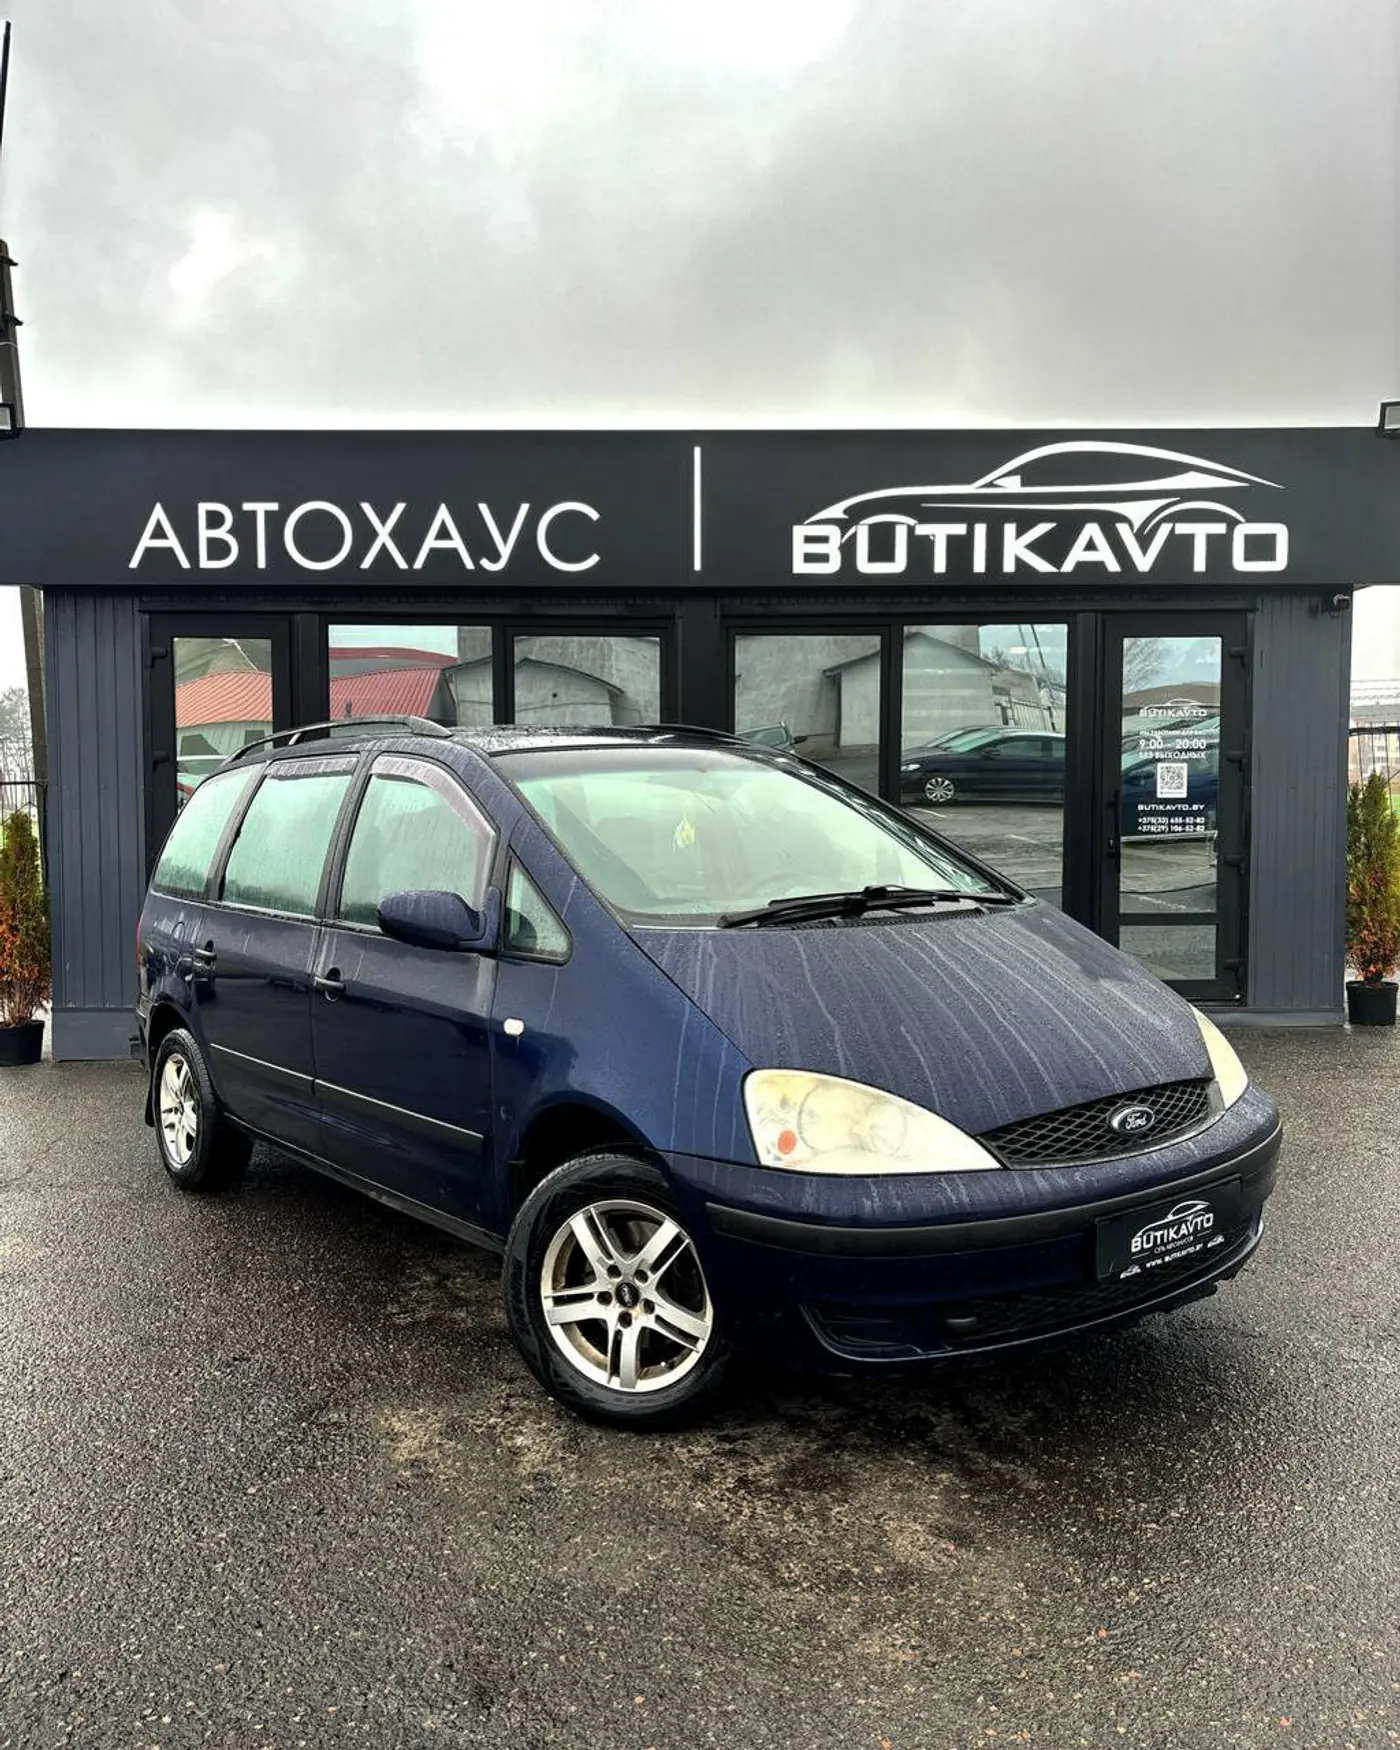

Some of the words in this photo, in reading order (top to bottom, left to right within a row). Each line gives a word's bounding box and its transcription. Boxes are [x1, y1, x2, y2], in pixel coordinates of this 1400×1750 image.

[129, 500, 601, 572] АВТОХАУС
[792, 522, 1289, 575] BUTIKAVTO
[1139, 739, 1163, 749] 9:00
[1175, 739, 1206, 749] 20:00
[1125, 1112, 1147, 1130] Ford
[1130, 1212, 1214, 1253] BUTIKAVTO
